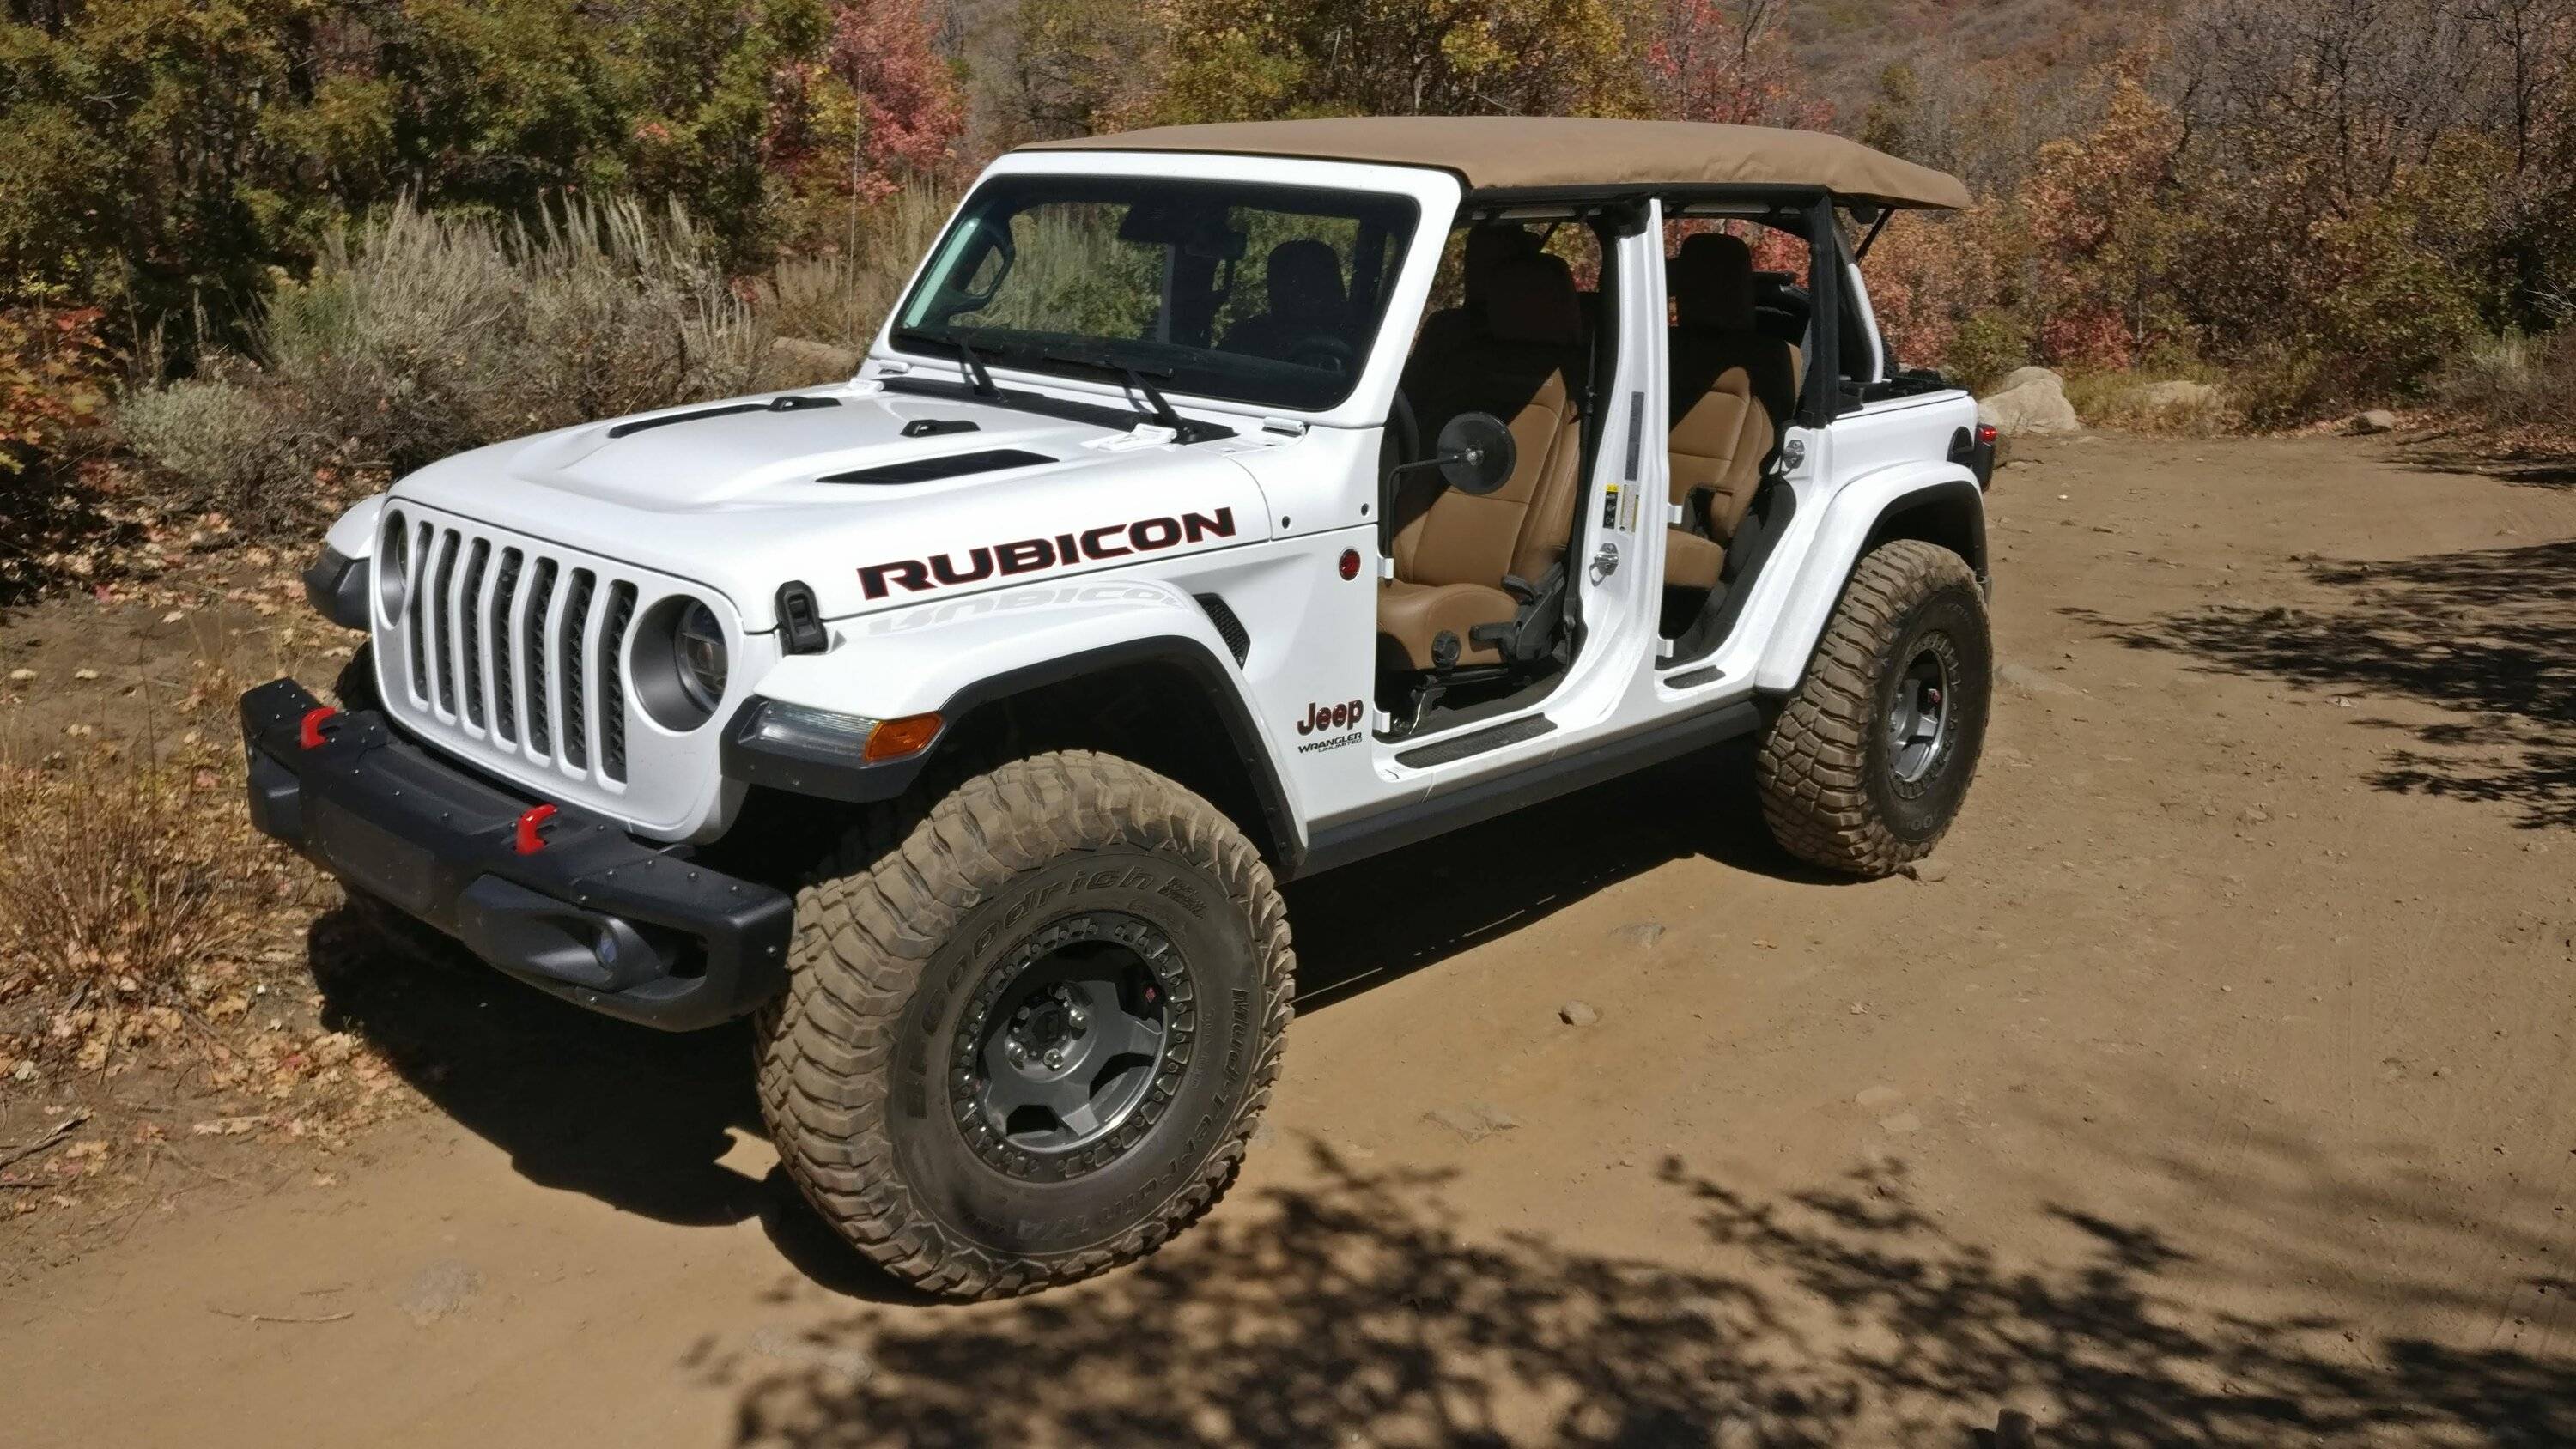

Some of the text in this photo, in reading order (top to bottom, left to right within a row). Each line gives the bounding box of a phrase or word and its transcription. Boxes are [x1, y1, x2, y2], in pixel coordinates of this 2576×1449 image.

[857, 506, 1236, 601] RUBICON
[1297, 699, 1364, 736] Jeep
[1297, 732, 1362, 753] WRANGLER
